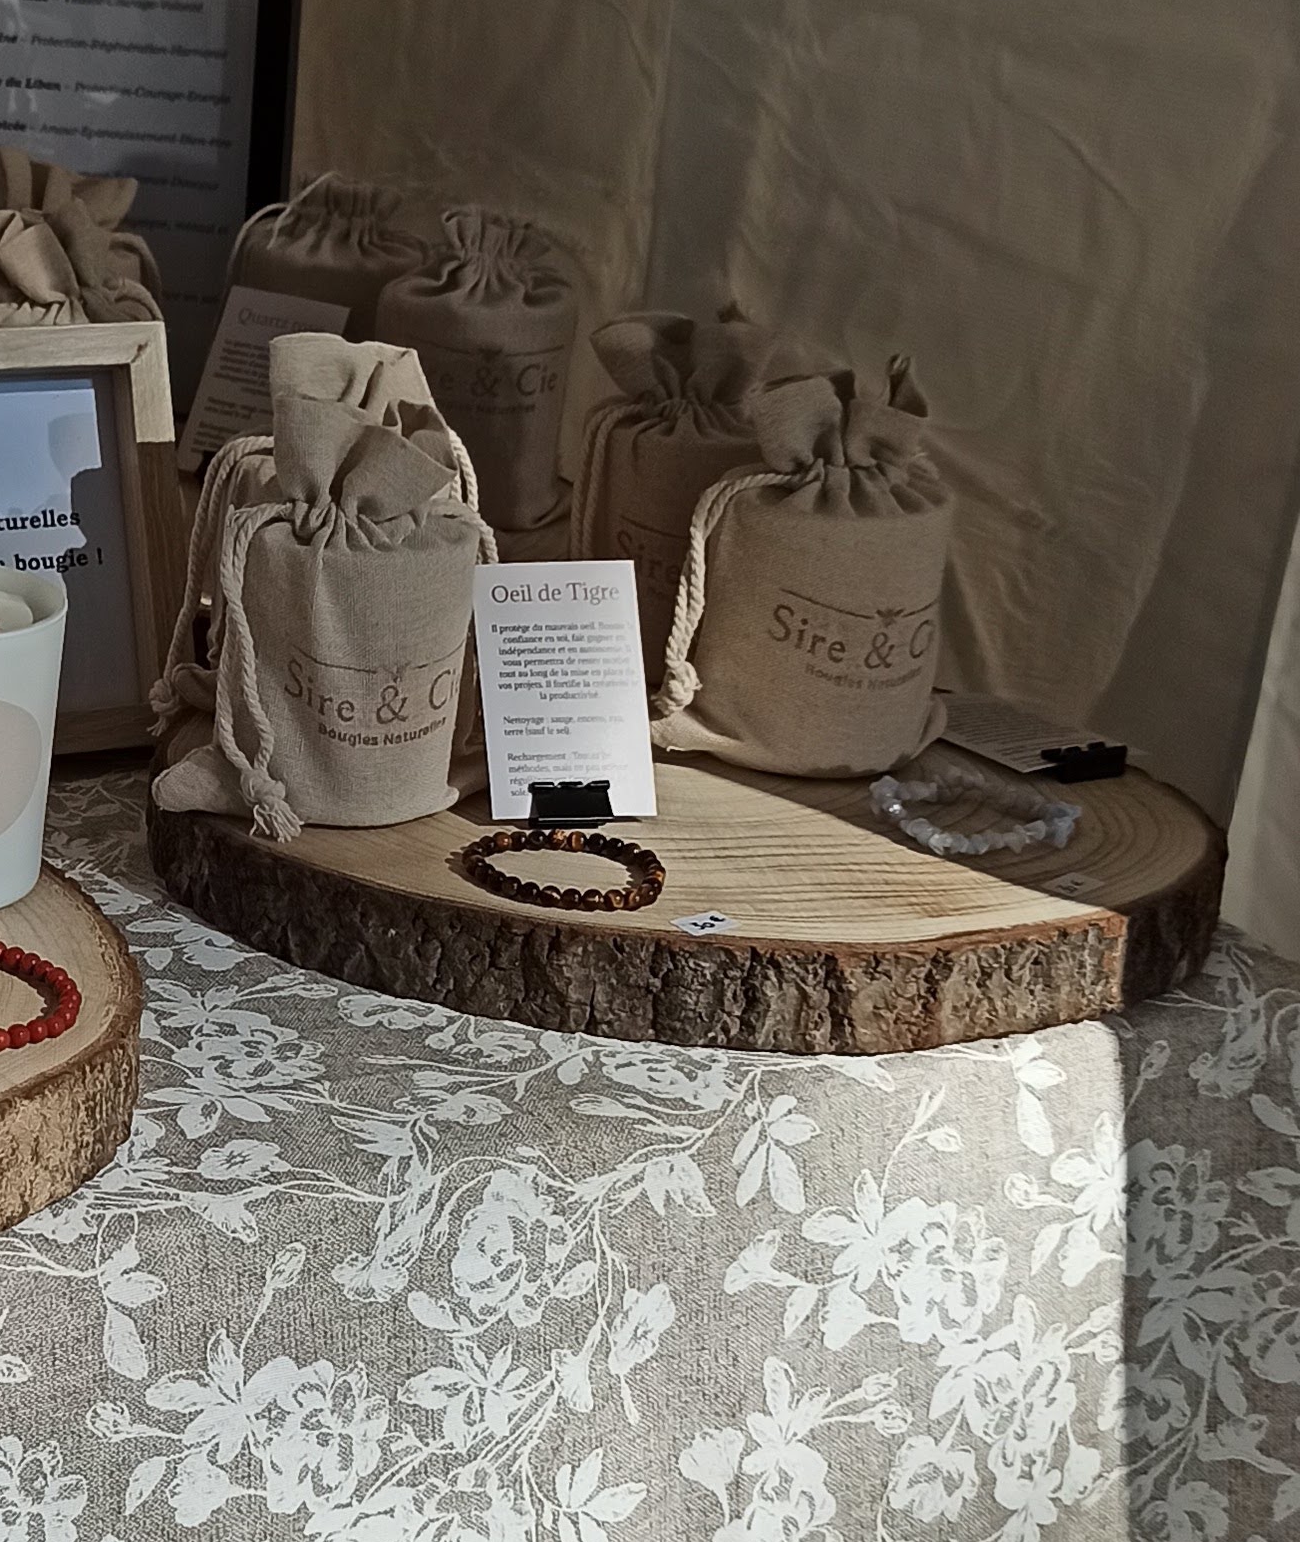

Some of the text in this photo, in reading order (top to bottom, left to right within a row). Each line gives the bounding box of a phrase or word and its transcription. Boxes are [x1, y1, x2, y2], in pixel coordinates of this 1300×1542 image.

[516, 363, 558, 397] Cie
[14, 549, 89, 574] bougie
[491, 581, 620, 606] Oeil de Tigre
[768, 603, 896, 670] Sire &
[284, 659, 410, 725] Sire &
